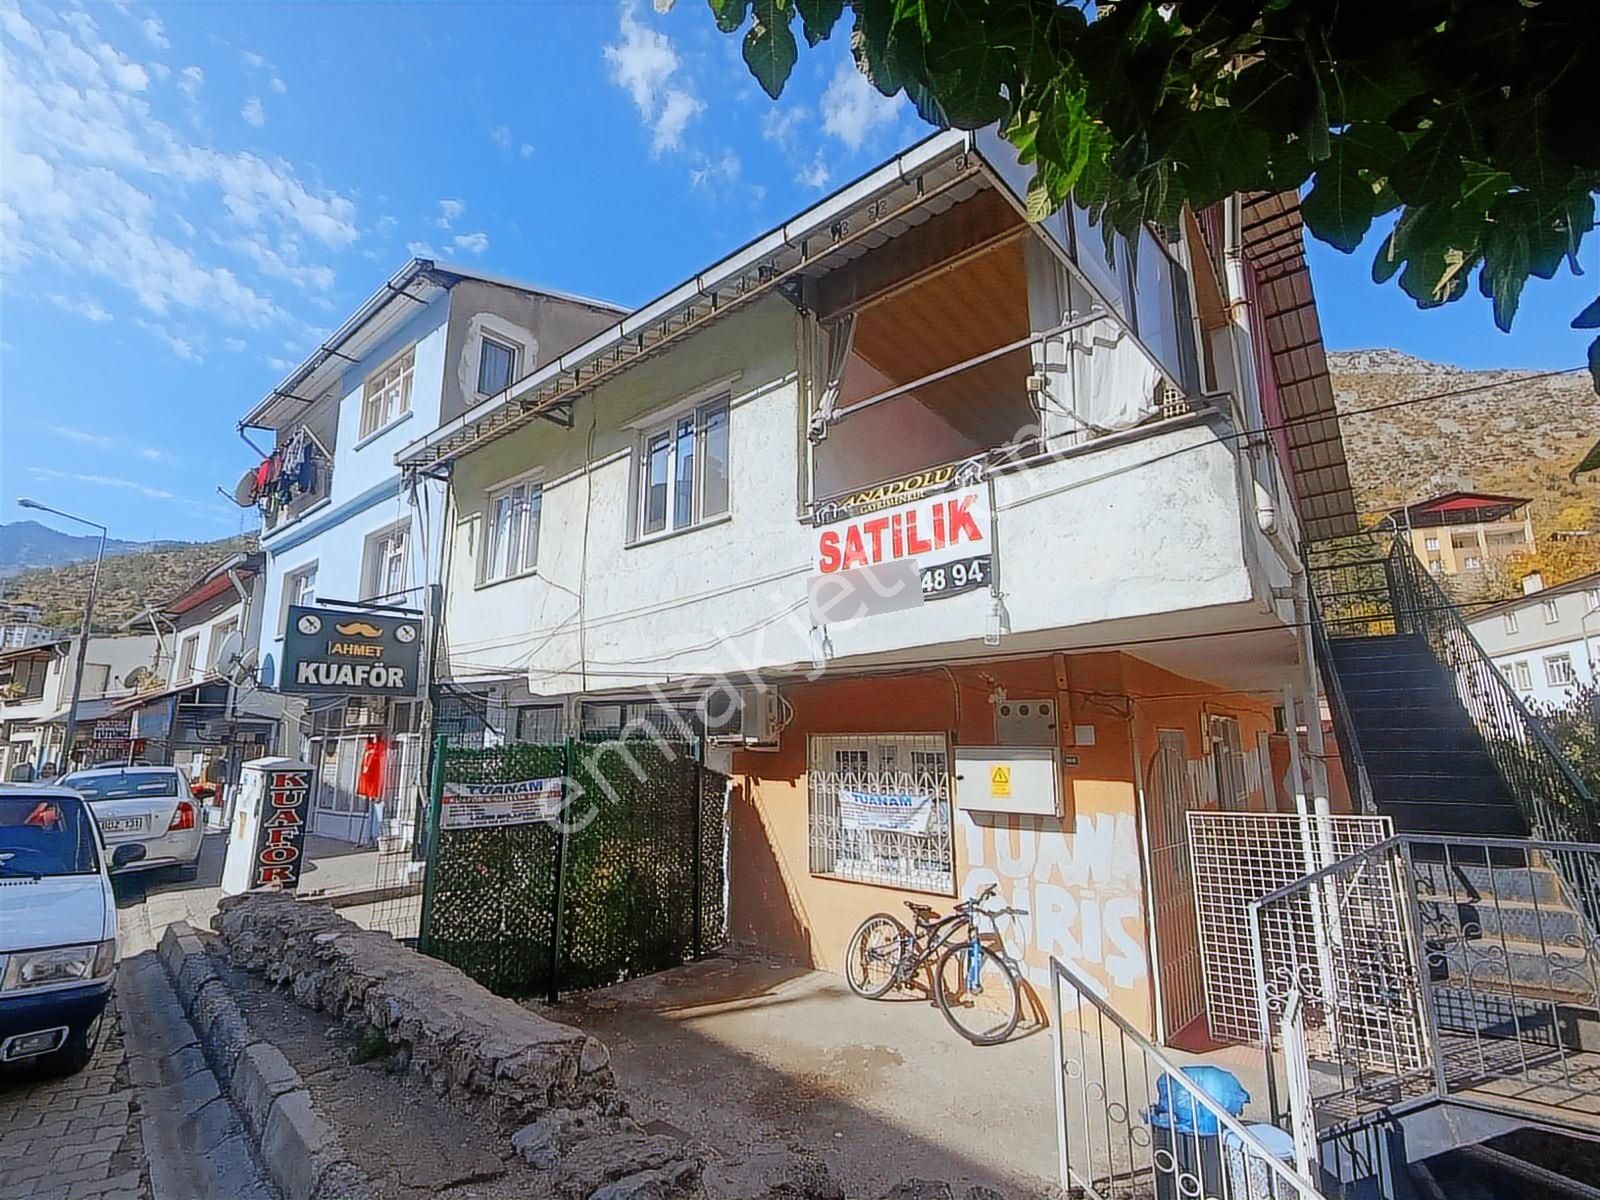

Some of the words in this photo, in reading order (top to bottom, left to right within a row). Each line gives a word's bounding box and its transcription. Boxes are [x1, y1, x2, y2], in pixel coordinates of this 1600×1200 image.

[843, 465, 955, 507] ANADOLU
[920, 569, 947, 592] 48
[952, 560, 984, 587] 94
[331, 642, 385, 658] AHMET
[296, 661, 405, 688] KUAFÖR
[466, 780, 544, 795] TUANAM
[851, 793, 913, 807] TUANAM
